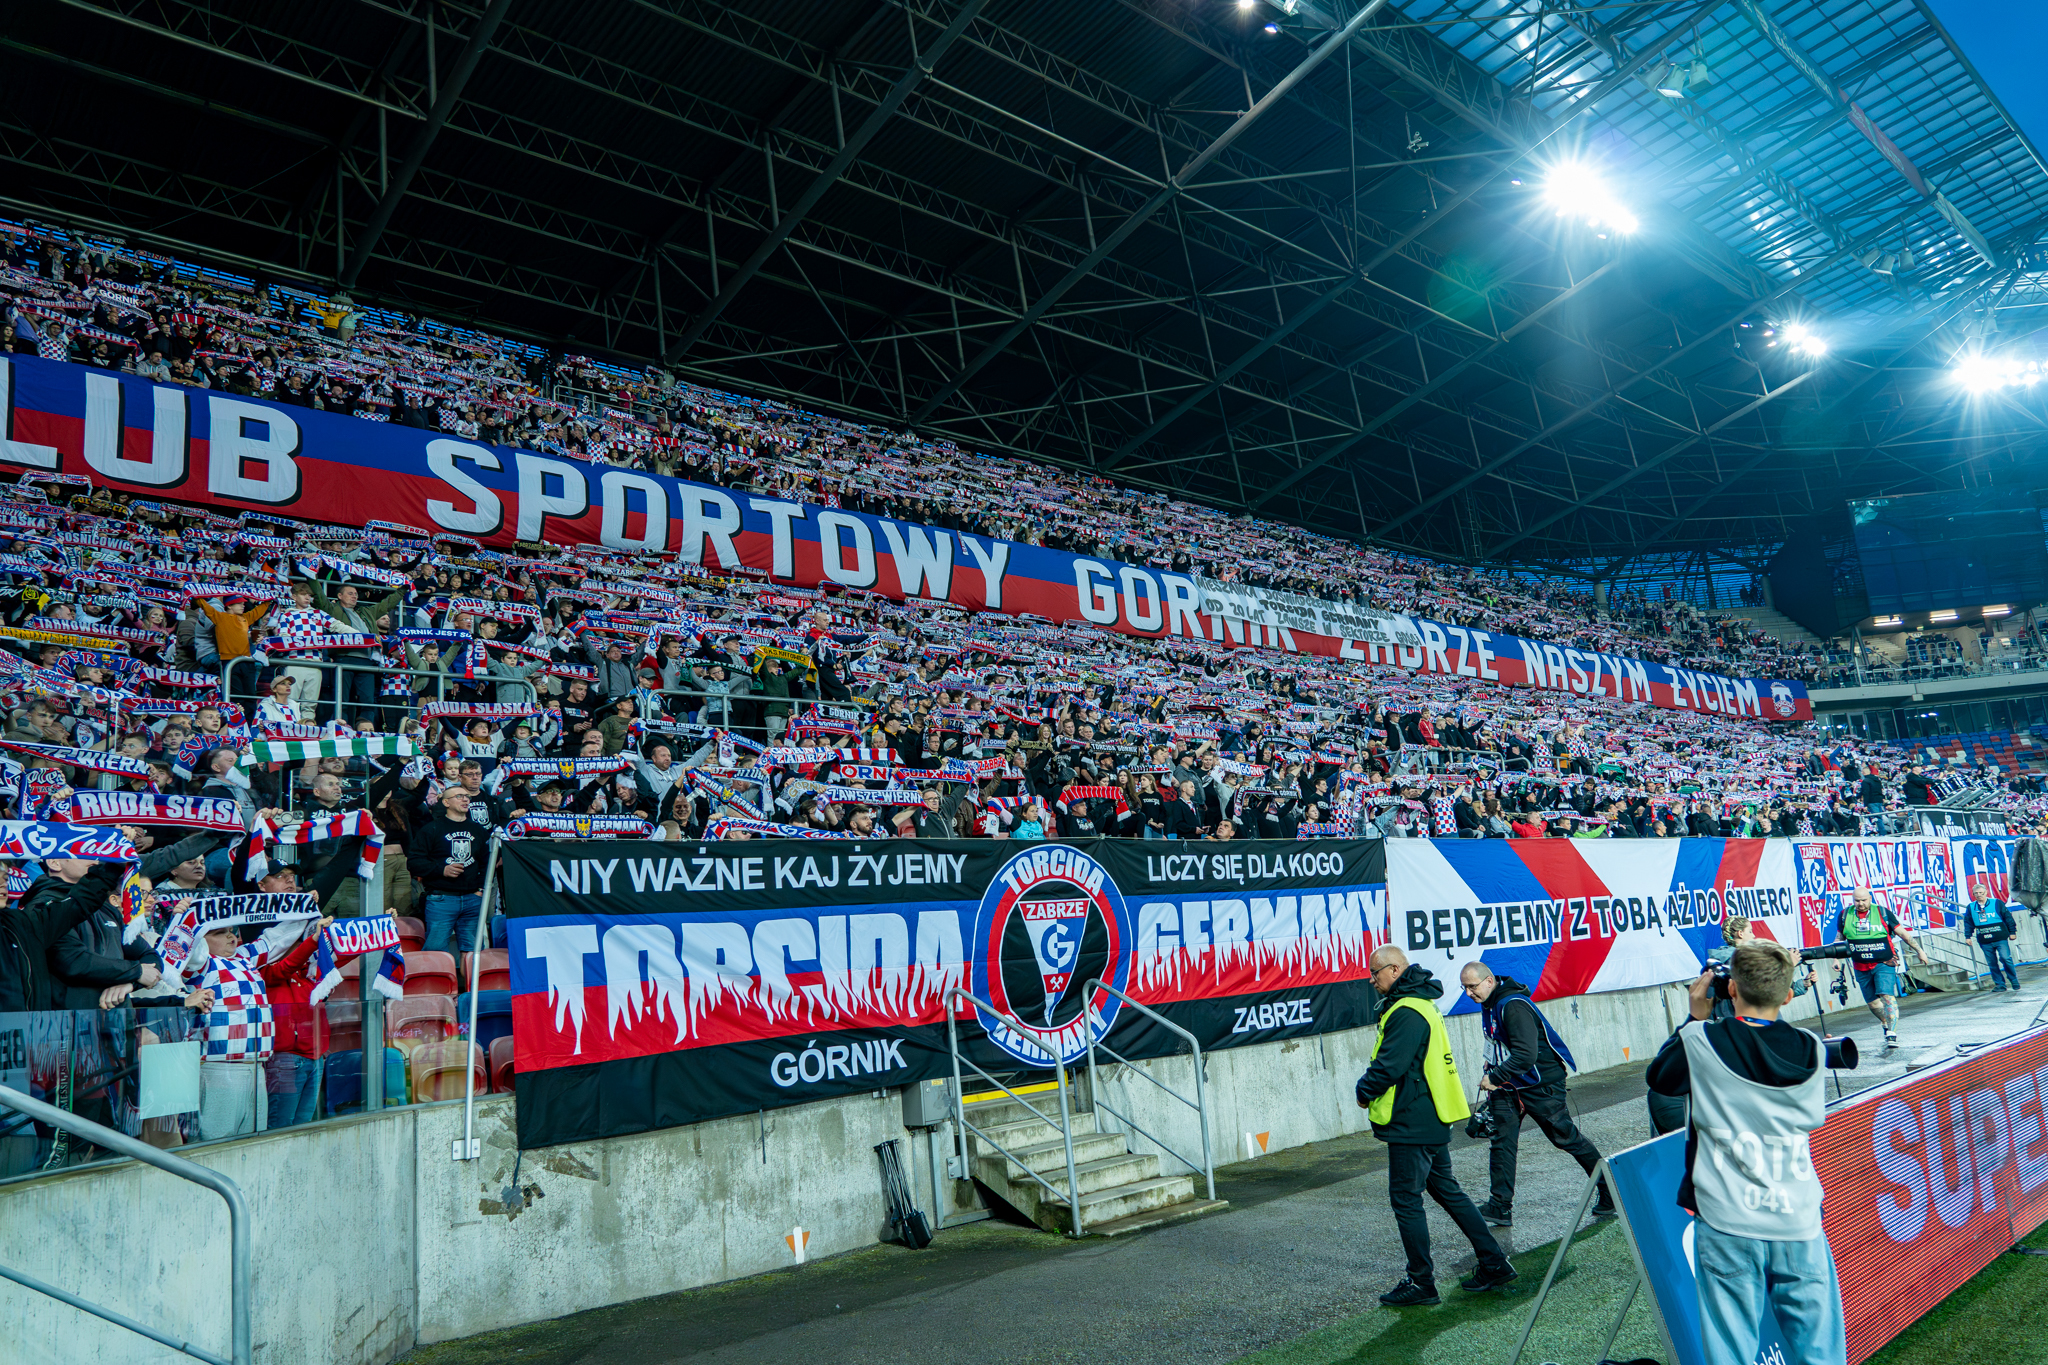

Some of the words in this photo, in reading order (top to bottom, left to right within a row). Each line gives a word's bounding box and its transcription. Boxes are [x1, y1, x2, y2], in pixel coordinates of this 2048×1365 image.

[426, 437, 1010, 608] SPORTOWY
[1518, 639, 1652, 702] NASZYM
[1661, 666, 1762, 717] ŻYCIEM
[1205, 598, 1224, 613] OD
[1228, 602, 1245, 617] 20
[1246, 606, 1266, 624] LAT
[1275, 611, 1317, 634] ZAWSZE
[1322, 621, 1333, 636] W
[1339, 624, 1391, 643] SEKTORZE
[1259, 599, 1317, 620] TORCIDA
[1321, 609, 1380, 630] GERMANY
[284, 633, 365, 650] PSZCZYNA
[429, 702, 471, 714] RUDA
[472, 744, 495, 755] NYC
[775, 751, 838, 764] ZABRZE
[576, 760, 626, 773] GERMANY
[77, 792, 157, 819] RUDA
[525, 817, 576, 831] TORCIDA
[592, 820, 644, 832] GERMANY
[550, 857, 620, 895] NIY
[625, 847, 765, 893] WAŻNE
[774, 855, 840, 889] KAJ
[847, 845, 969, 887] ŻYJEMY
[1000, 848, 1105, 896] TORCIDA
[1147, 854, 1208, 882] LICZY
[1210, 853, 1245, 886] SIĘ
[1247, 852, 1284, 879] DLA
[1284, 851, 1344, 877] KOGO
[1025, 900, 1086, 920] ZABRZE
[1406, 900, 1563, 961] BĘDZIEMY
[1570, 899, 1590, 937] Z
[1600, 897, 1666, 938] TOBĄ
[1668, 882, 1693, 928] AŻ
[1699, 889, 1721, 924] DO
[1725, 880, 1793, 917] ŚMIERCI
[1137, 889, 1387, 993] GERMANY
[1871, 924, 1883, 932] TV
[524, 910, 966, 1056] TORCIDA
[1232, 998, 1313, 1034] ZABRZE
[770, 1039, 908, 1088] GÓRNIK
[1744, 1187, 1794, 1214] 041
